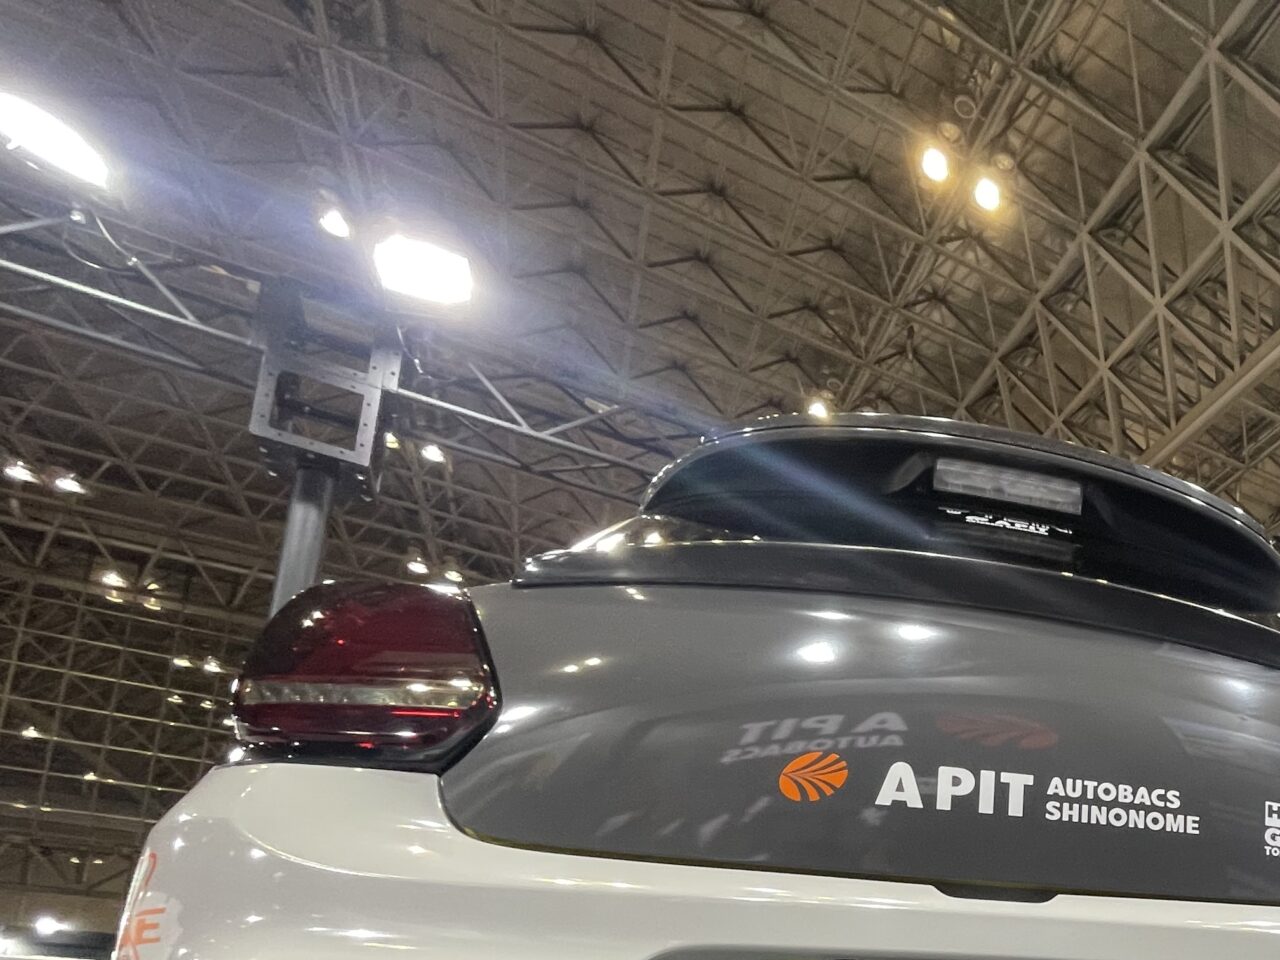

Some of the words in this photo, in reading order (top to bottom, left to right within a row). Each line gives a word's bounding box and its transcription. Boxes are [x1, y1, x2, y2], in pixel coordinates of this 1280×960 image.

[875, 761, 924, 809] A
[936, 766, 1034, 817] PIT
[1047, 777, 1181, 809] AUTOBACS
[1045, 801, 1201, 835] SHINONOME
